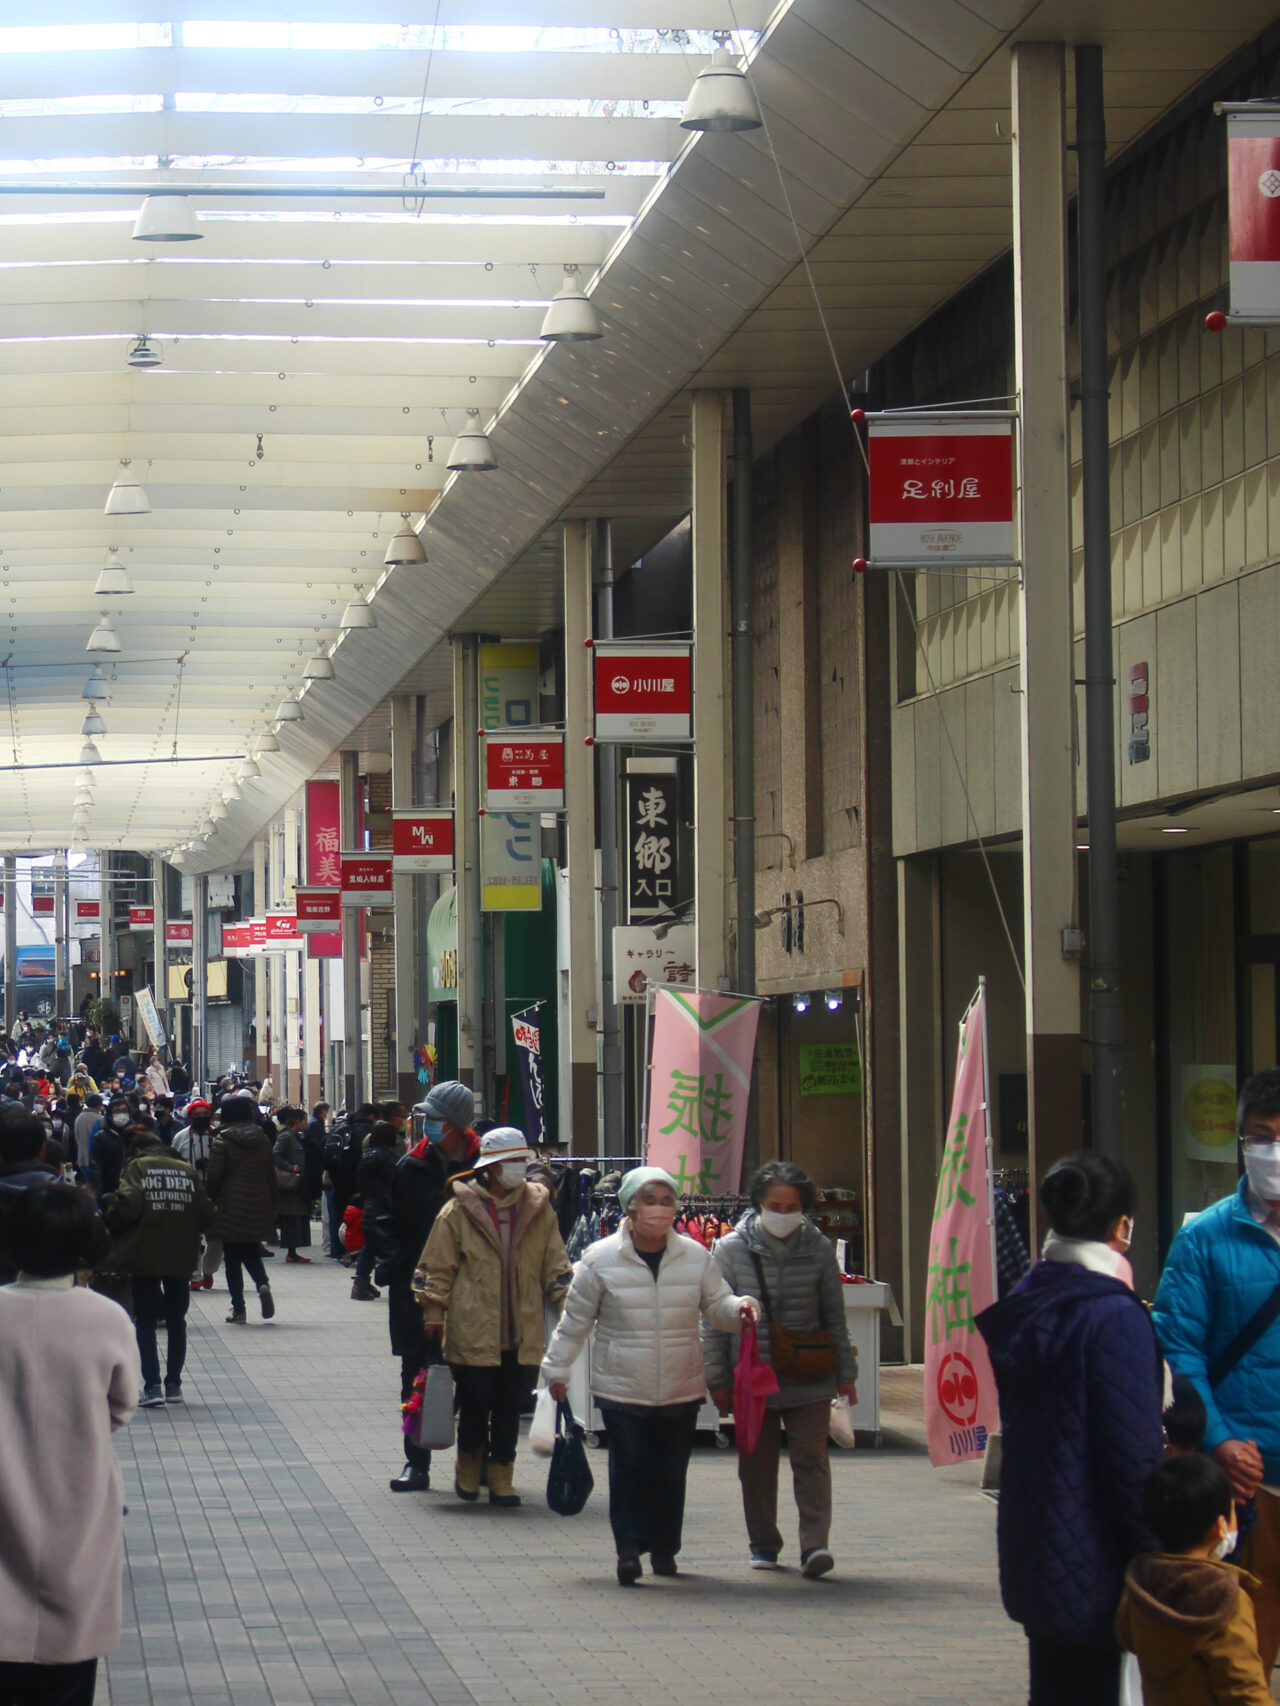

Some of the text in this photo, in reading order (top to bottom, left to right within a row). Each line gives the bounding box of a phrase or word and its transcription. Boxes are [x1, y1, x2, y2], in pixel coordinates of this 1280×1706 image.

[902, 477, 981, 499] 足利屋
[633, 678, 675, 692] 小川屋
[634, 787, 671, 875] 東郷
[315, 826, 341, 887] 福美
[634, 879, 672, 896] 入口
[626, 949, 675, 959] ギャラリー
